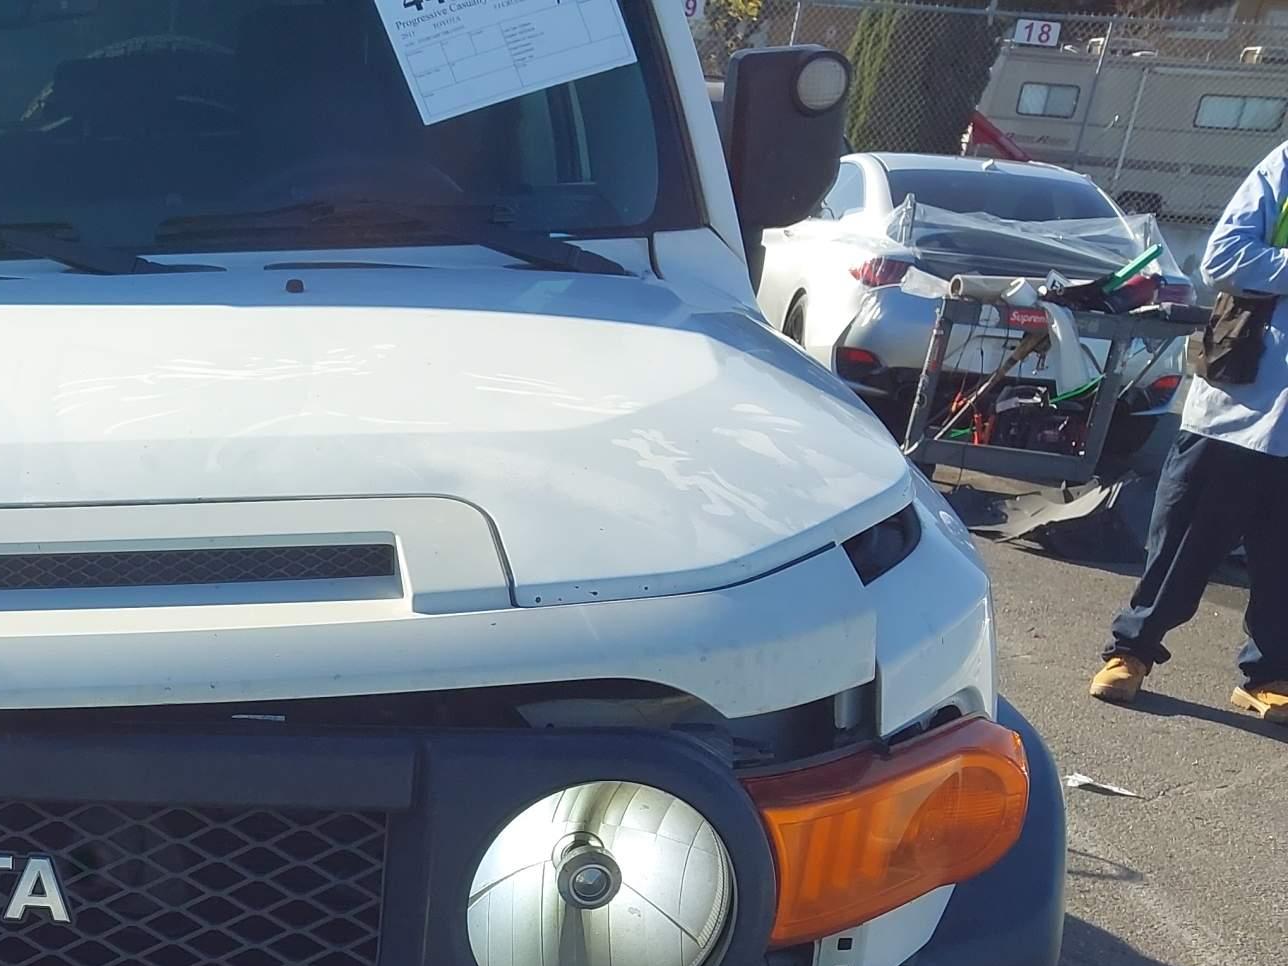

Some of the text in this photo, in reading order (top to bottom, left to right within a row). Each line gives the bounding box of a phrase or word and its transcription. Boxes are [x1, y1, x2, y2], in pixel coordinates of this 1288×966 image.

[395, 8, 448, 31] Progressive
[1025, 22, 1052, 43] 18
[1010, 311, 1048, 325] Suprem
